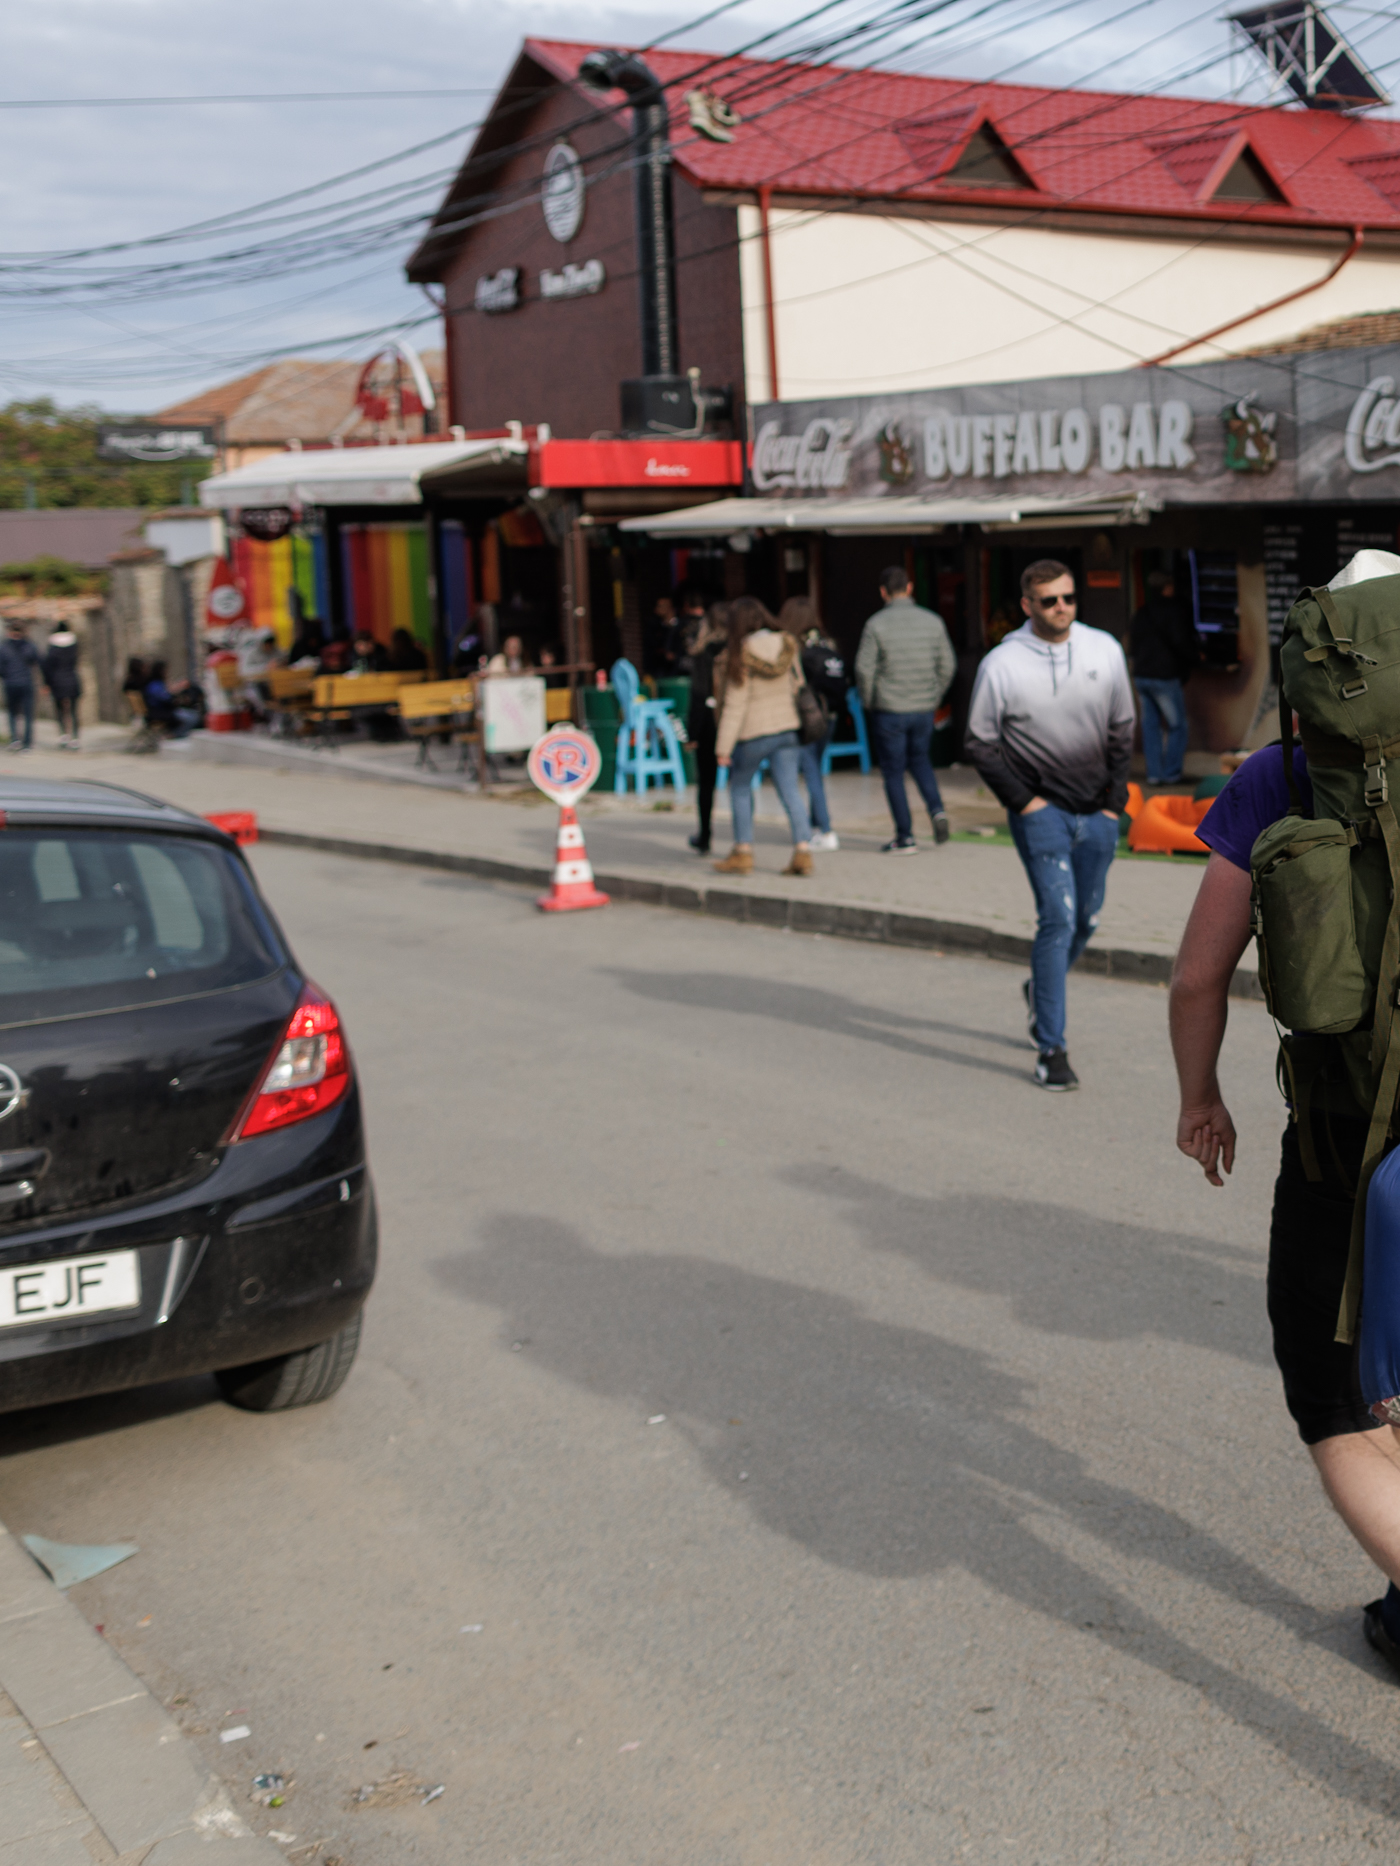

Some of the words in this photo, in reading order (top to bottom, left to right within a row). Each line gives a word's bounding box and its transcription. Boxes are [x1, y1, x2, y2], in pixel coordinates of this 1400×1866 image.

[923, 408, 1092, 479] BUFFALO
[1102, 400, 1195, 474] BAR
[14, 1260, 108, 1315] EJF
